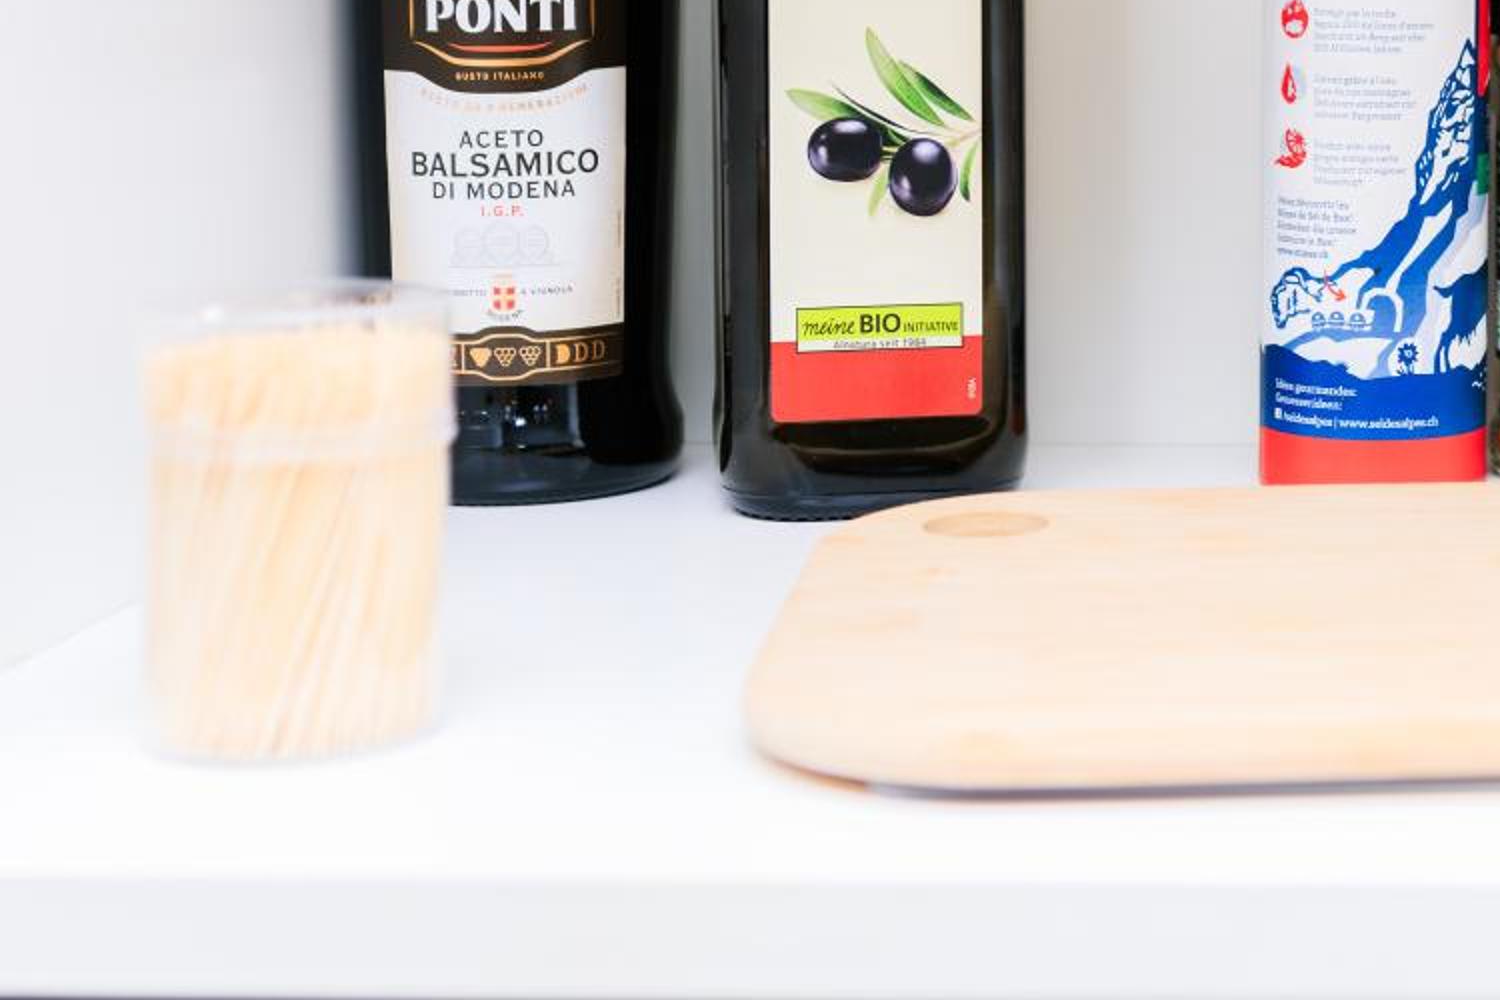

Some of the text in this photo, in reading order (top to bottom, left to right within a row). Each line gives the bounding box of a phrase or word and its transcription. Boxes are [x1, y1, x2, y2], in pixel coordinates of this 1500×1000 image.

[455, 70, 546, 83] GUSTO ITALIANO
[459, 128, 545, 150] ACETO
[411, 148, 600, 178] BALSAMICO
[432, 179, 577, 200] DI MODENA
[801, 312, 959, 336] meine BIO INITIATIVE
